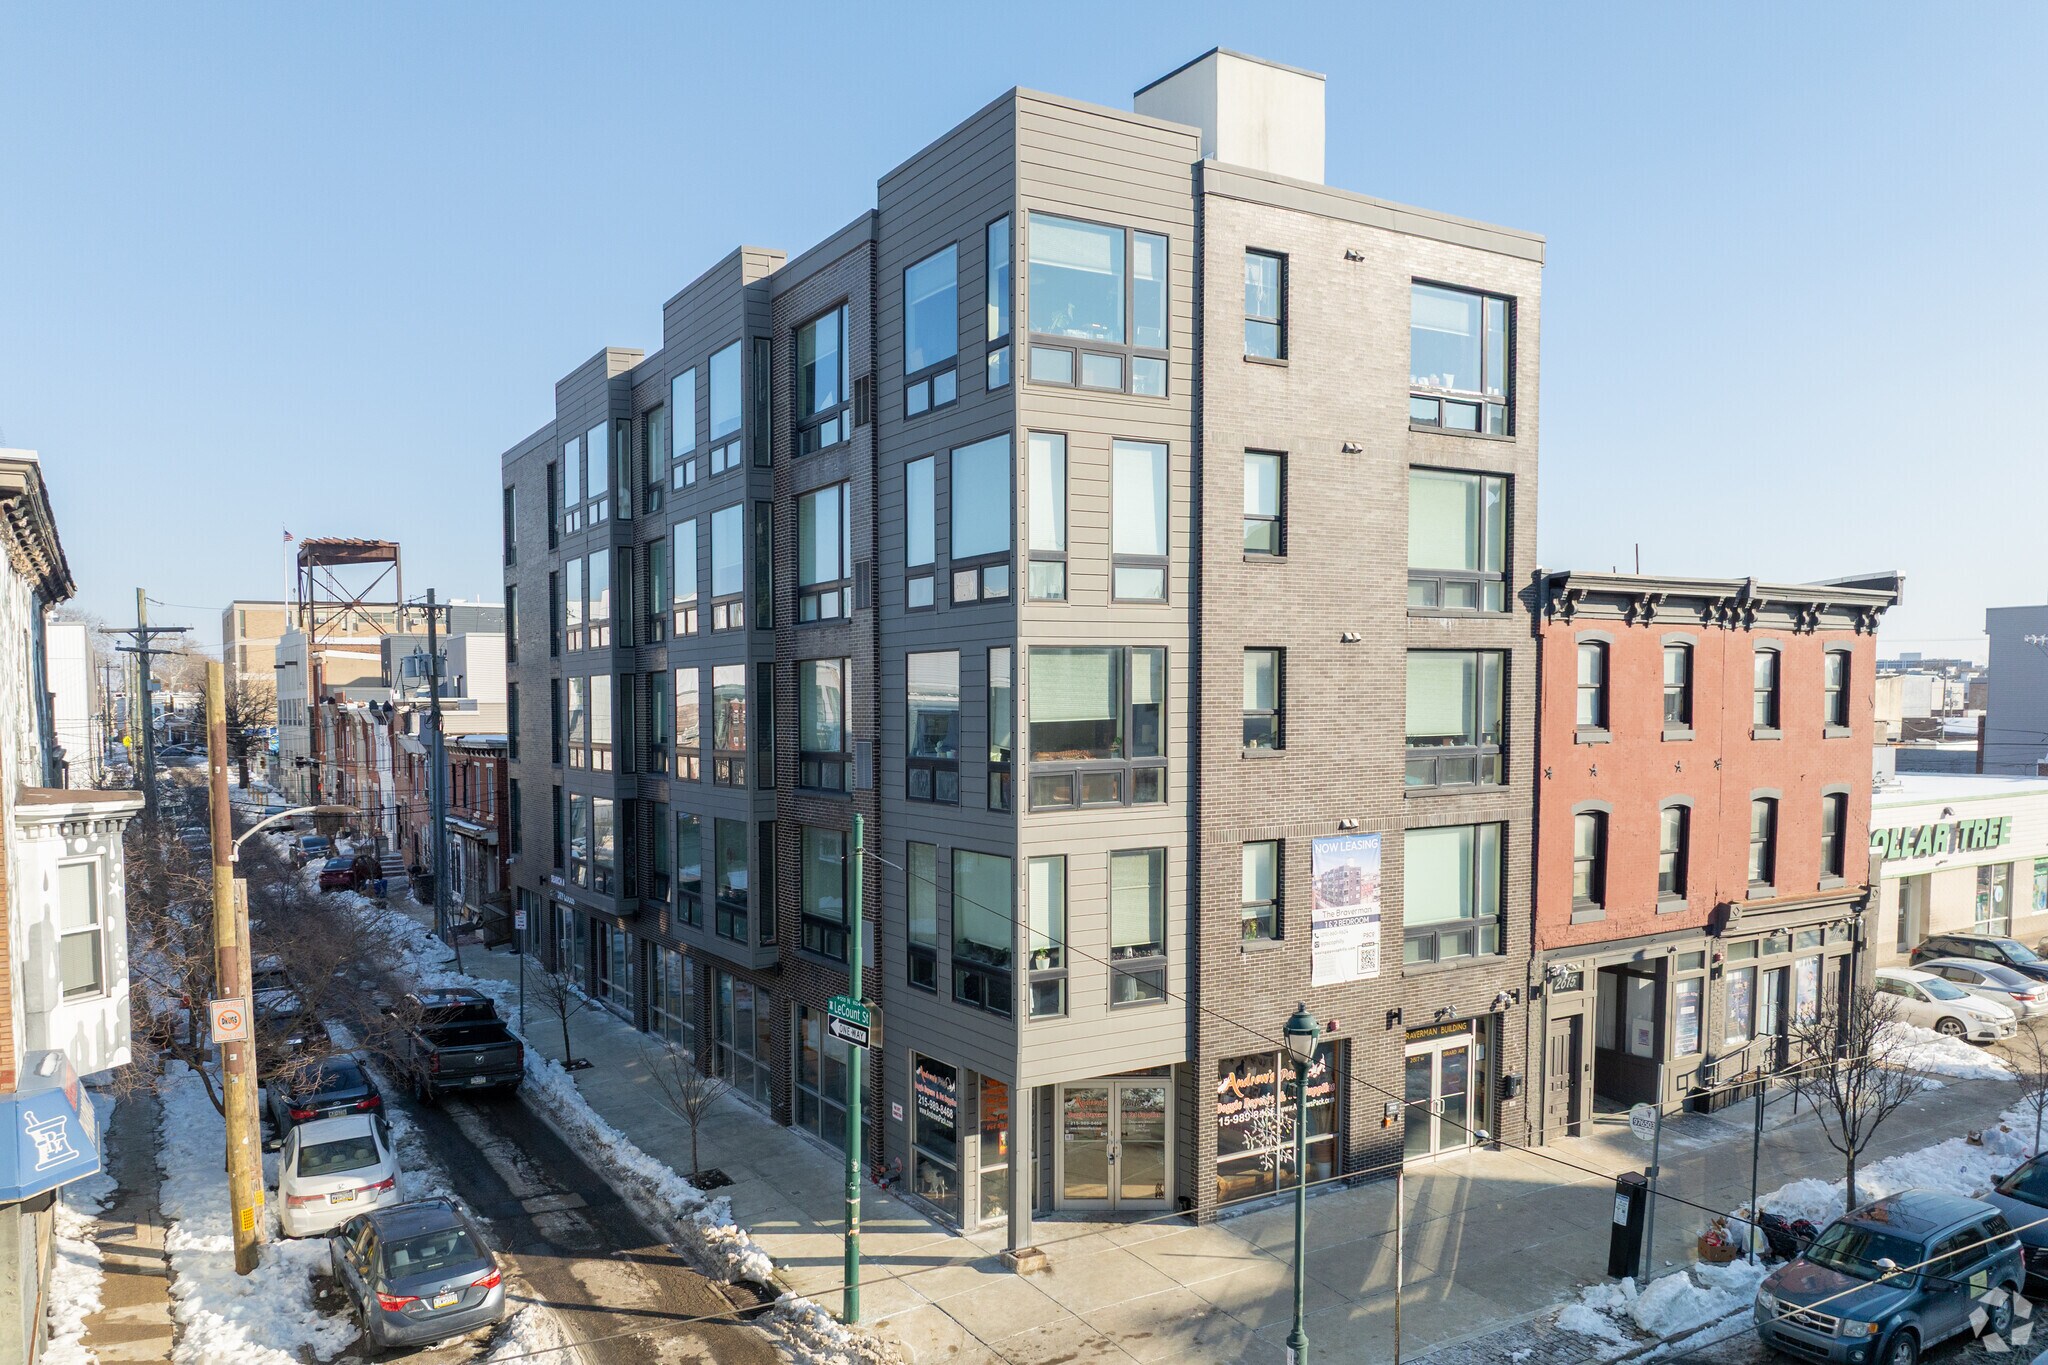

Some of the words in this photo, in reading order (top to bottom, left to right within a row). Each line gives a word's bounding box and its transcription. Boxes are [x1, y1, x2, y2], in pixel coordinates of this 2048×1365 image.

[1870, 823, 1950, 860] OLLAR
[1958, 816, 2013, 850] TREE
[1314, 842, 1339, 854] NOW
[1340, 839, 1378, 852] LEASING
[1322, 911, 1335, 919] The
[1336, 906, 1373, 917] Braverman
[1338, 916, 1370, 926] BEDROOM
[1555, 975, 1577, 990] 2615
[834, 1001, 860, 1021] LeCount
[862, 1011, 869, 1024] St
[840, 1024, 850, 1036] ONE
[851, 1028, 865, 1040] WAY
[1406, 1028, 1438, 1040] RAVERMAN
[1440, 1022, 1467, 1034] BUILDING
[1222, 1069, 1275, 1098] Andrew's
[918, 1094, 954, 1119] 215-989-8468
[1217, 1100, 1243, 1115] Doggie
